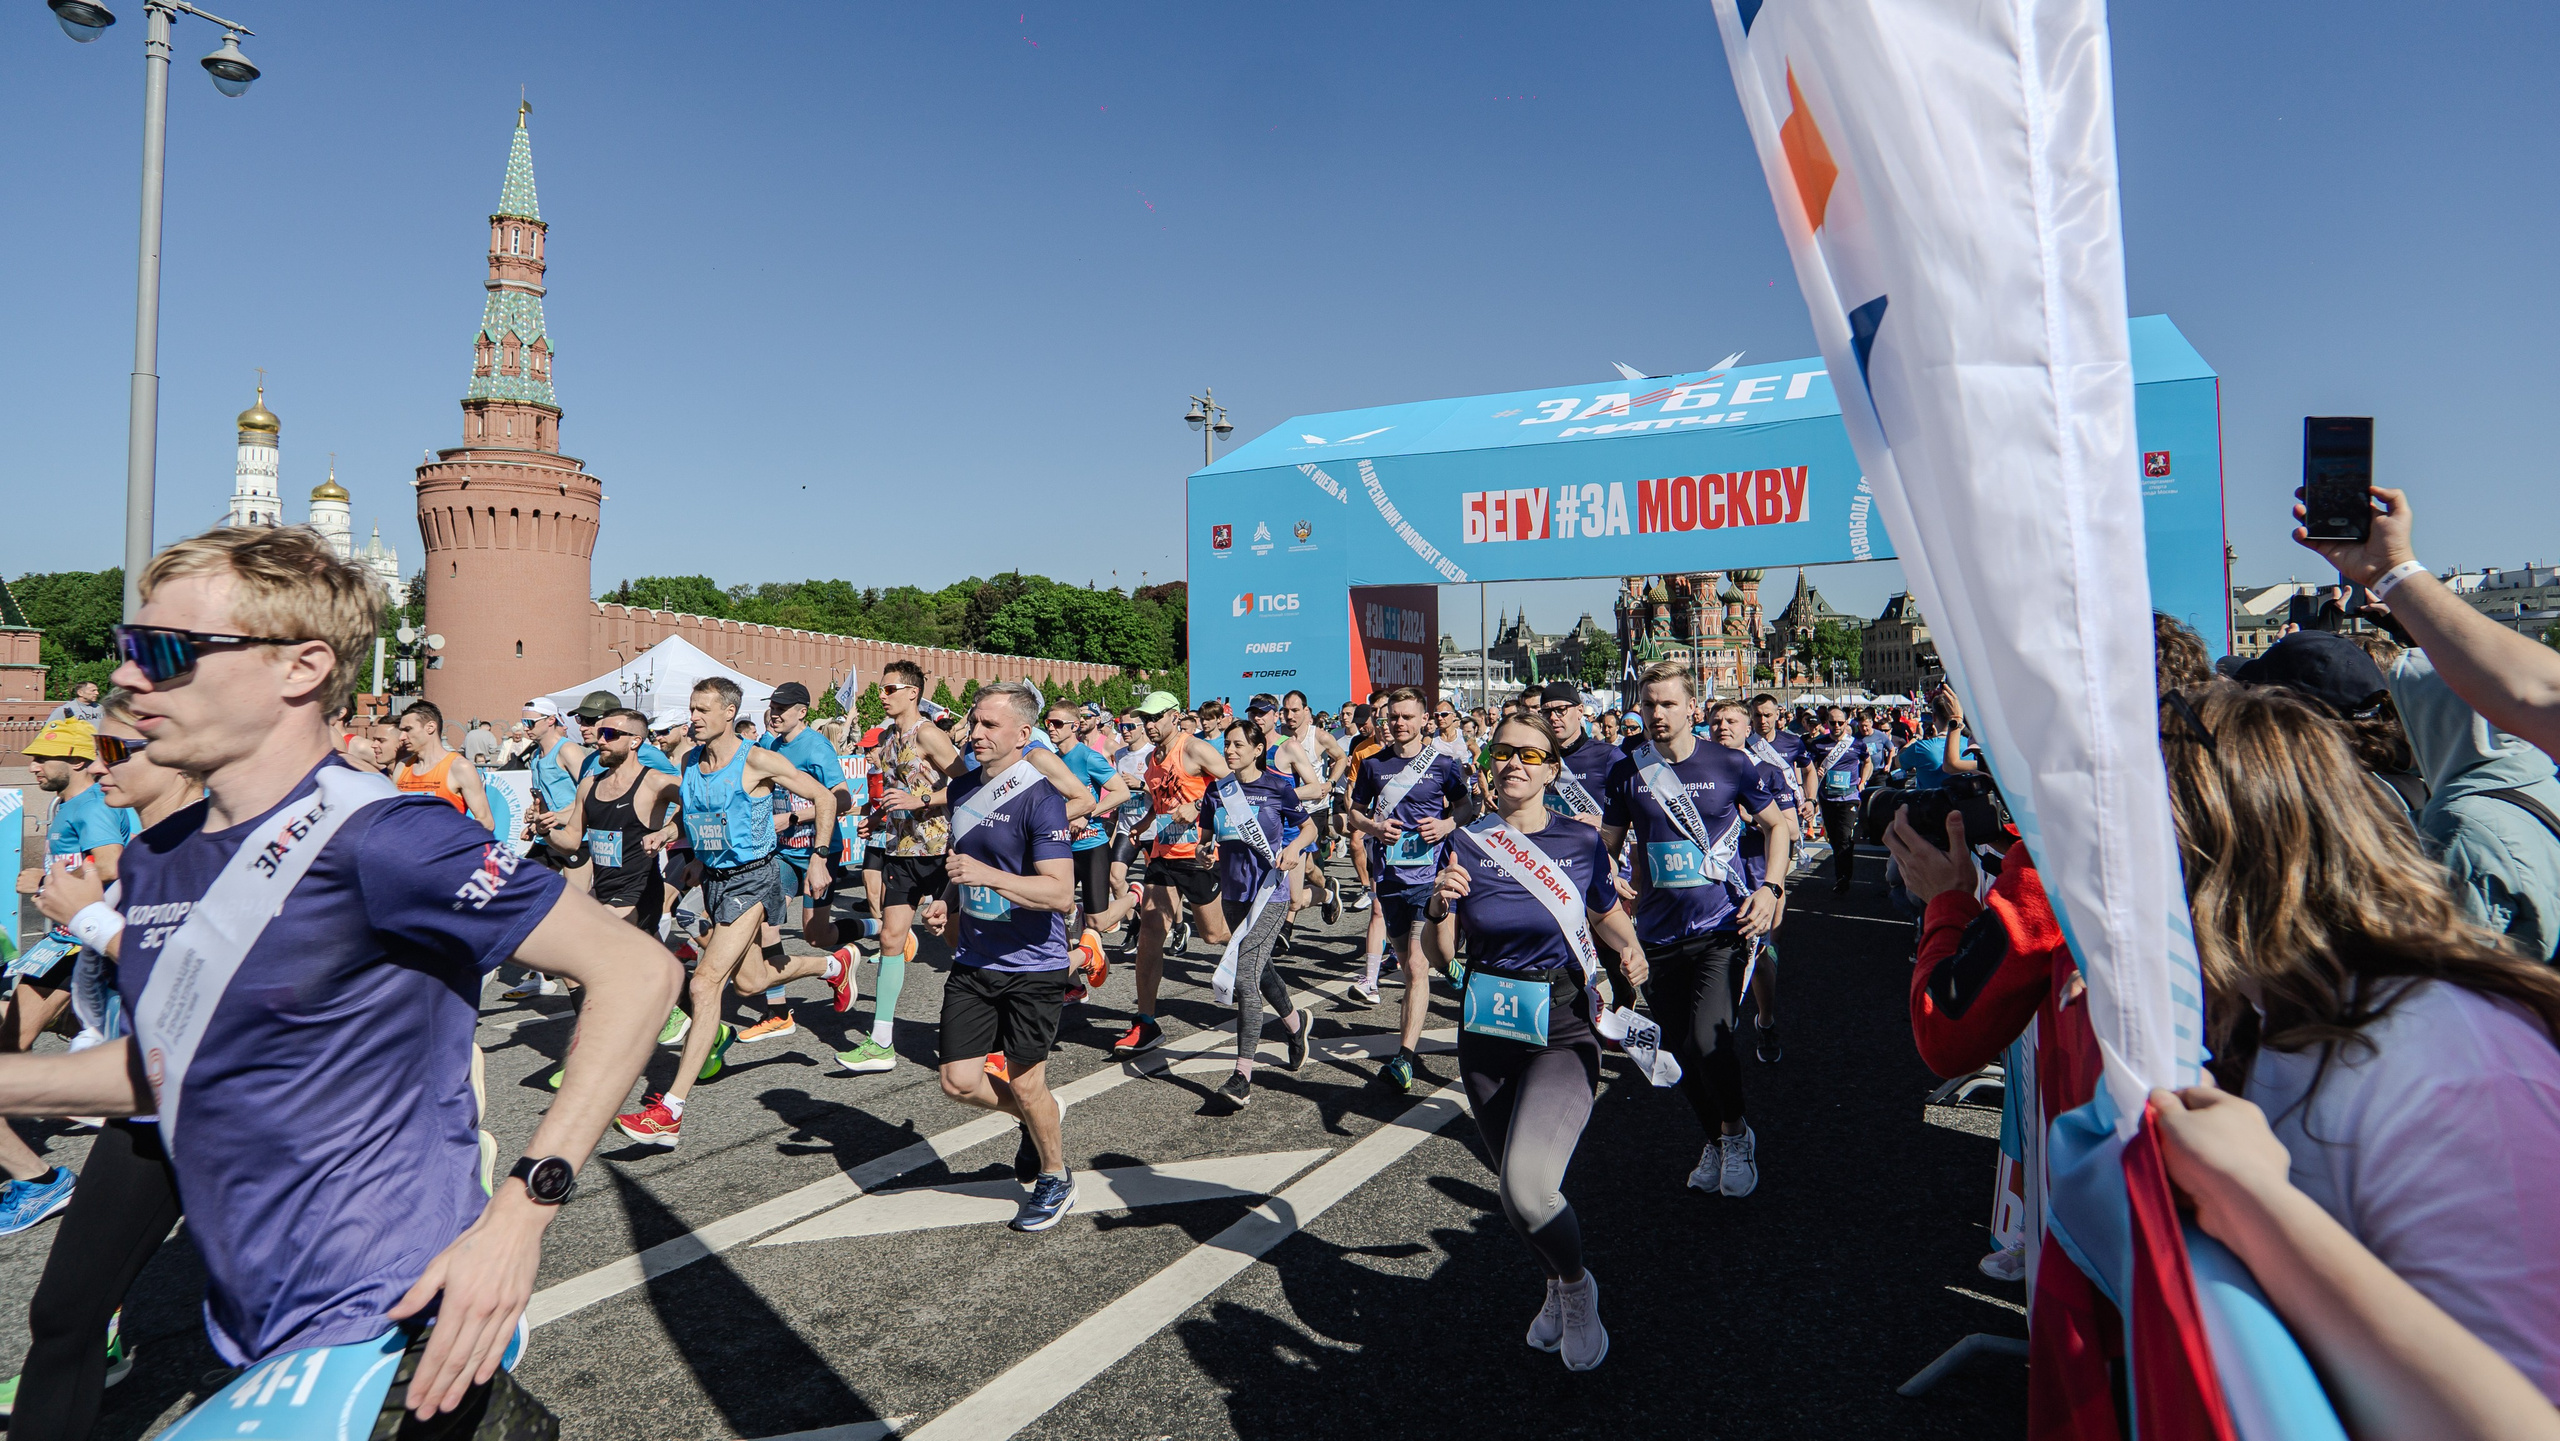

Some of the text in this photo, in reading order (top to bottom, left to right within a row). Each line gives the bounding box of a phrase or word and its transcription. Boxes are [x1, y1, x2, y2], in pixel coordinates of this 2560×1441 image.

[1357, 459, 1403, 527] #АДРЕНАЛИН
[1395, 521, 1441, 565] #МОМЕНТ
[1462, 465, 1810, 544] БЕГУ #ЗА МОСКВУ
[1259, 593, 1300, 612] ПСБ
[1402, 609, 1425, 644] 2024
[1245, 641, 1292, 654] FONBET
[1254, 669, 1297, 678] TORERO
[1369, 648, 1424, 689] #ЕДИНСТВО
[699, 825, 722, 838] 42512
[1403, 839, 1418, 853] 8-1
[1491, 830, 1572, 906] Альфа Банк
[1664, 852, 1695, 872] 30-1
[970, 886, 992, 904] 12-1
[1493, 992, 1518, 1018] 2-1
[229, 1348, 332, 1409] 41-1
